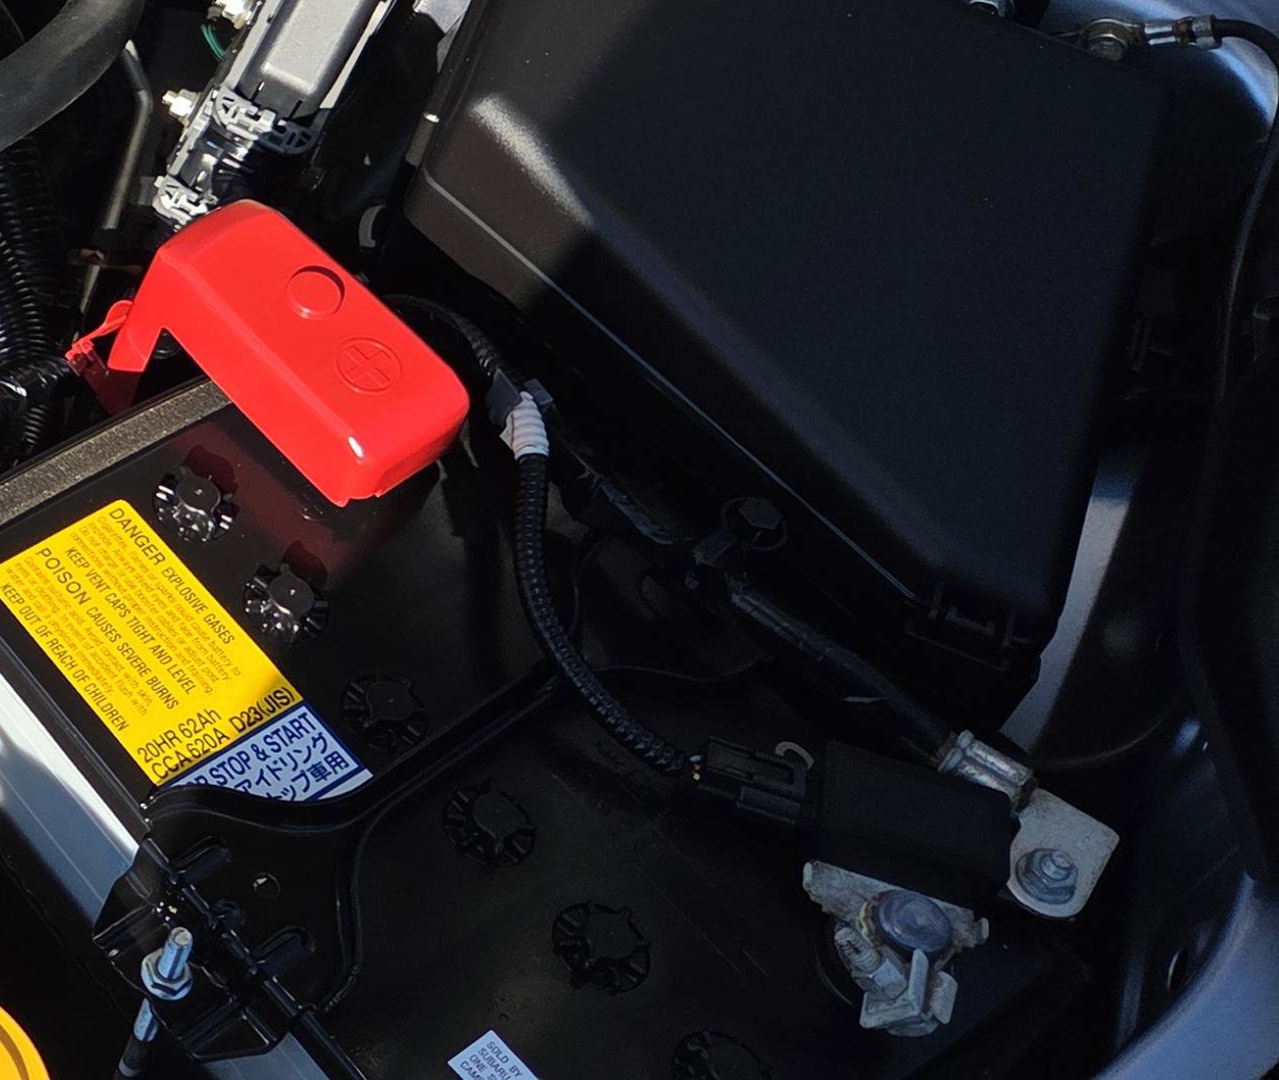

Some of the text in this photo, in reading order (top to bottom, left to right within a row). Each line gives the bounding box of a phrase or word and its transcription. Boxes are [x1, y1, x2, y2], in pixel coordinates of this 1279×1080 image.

[64, 545, 198, 695] KEEP VENT CAPS TIGHT AND LEVEL
[108, 506, 236, 645] DANGER EXPLOSIVE GASES
[17, 604, 42, 627] OUT
[33, 623, 53, 640] OF
[44, 637, 79, 671] REACH
[70, 668, 90, 685] OF
[82, 681, 130, 732] CHILDREN
[35, 546, 180, 710] POISON CAUSES SEVERE BURNS
[137, 707, 223, 764] 20HR 62Ah
[151, 686, 296, 780] CCA 620A D23(JIS)
[210, 711, 317, 786] STOP & START
[469, 1054, 488, 1072] ONE
[486, 1041, 524, 1077] SOLD BY
